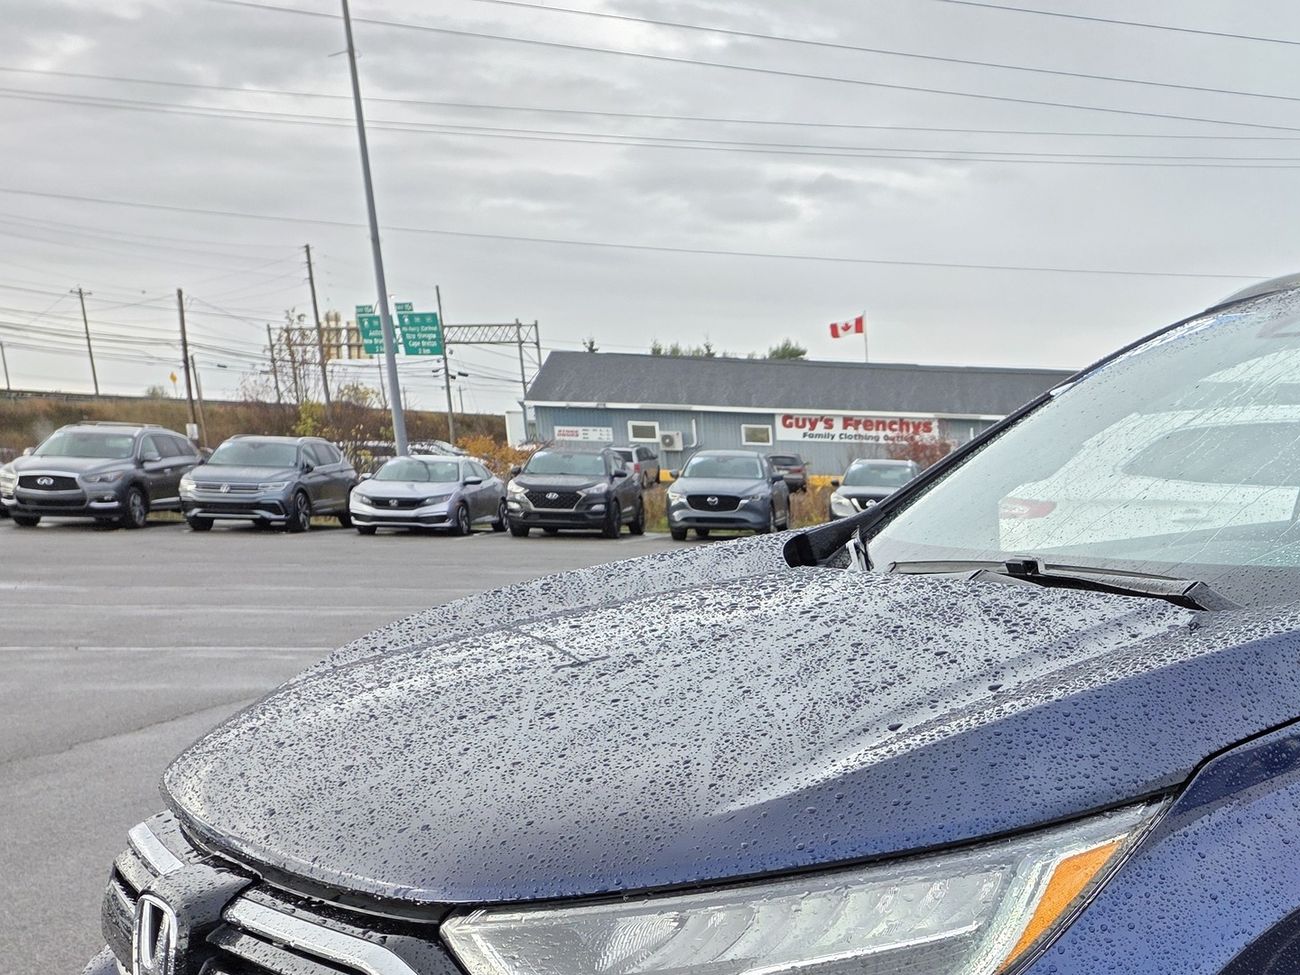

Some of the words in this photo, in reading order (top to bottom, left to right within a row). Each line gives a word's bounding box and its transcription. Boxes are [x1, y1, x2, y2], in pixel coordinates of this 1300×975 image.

[781, 413, 834, 431] Guy's
[842, 416, 933, 435] Frenchys
[802, 431, 836, 441] Family
[838, 432, 880, 442] Clothing
